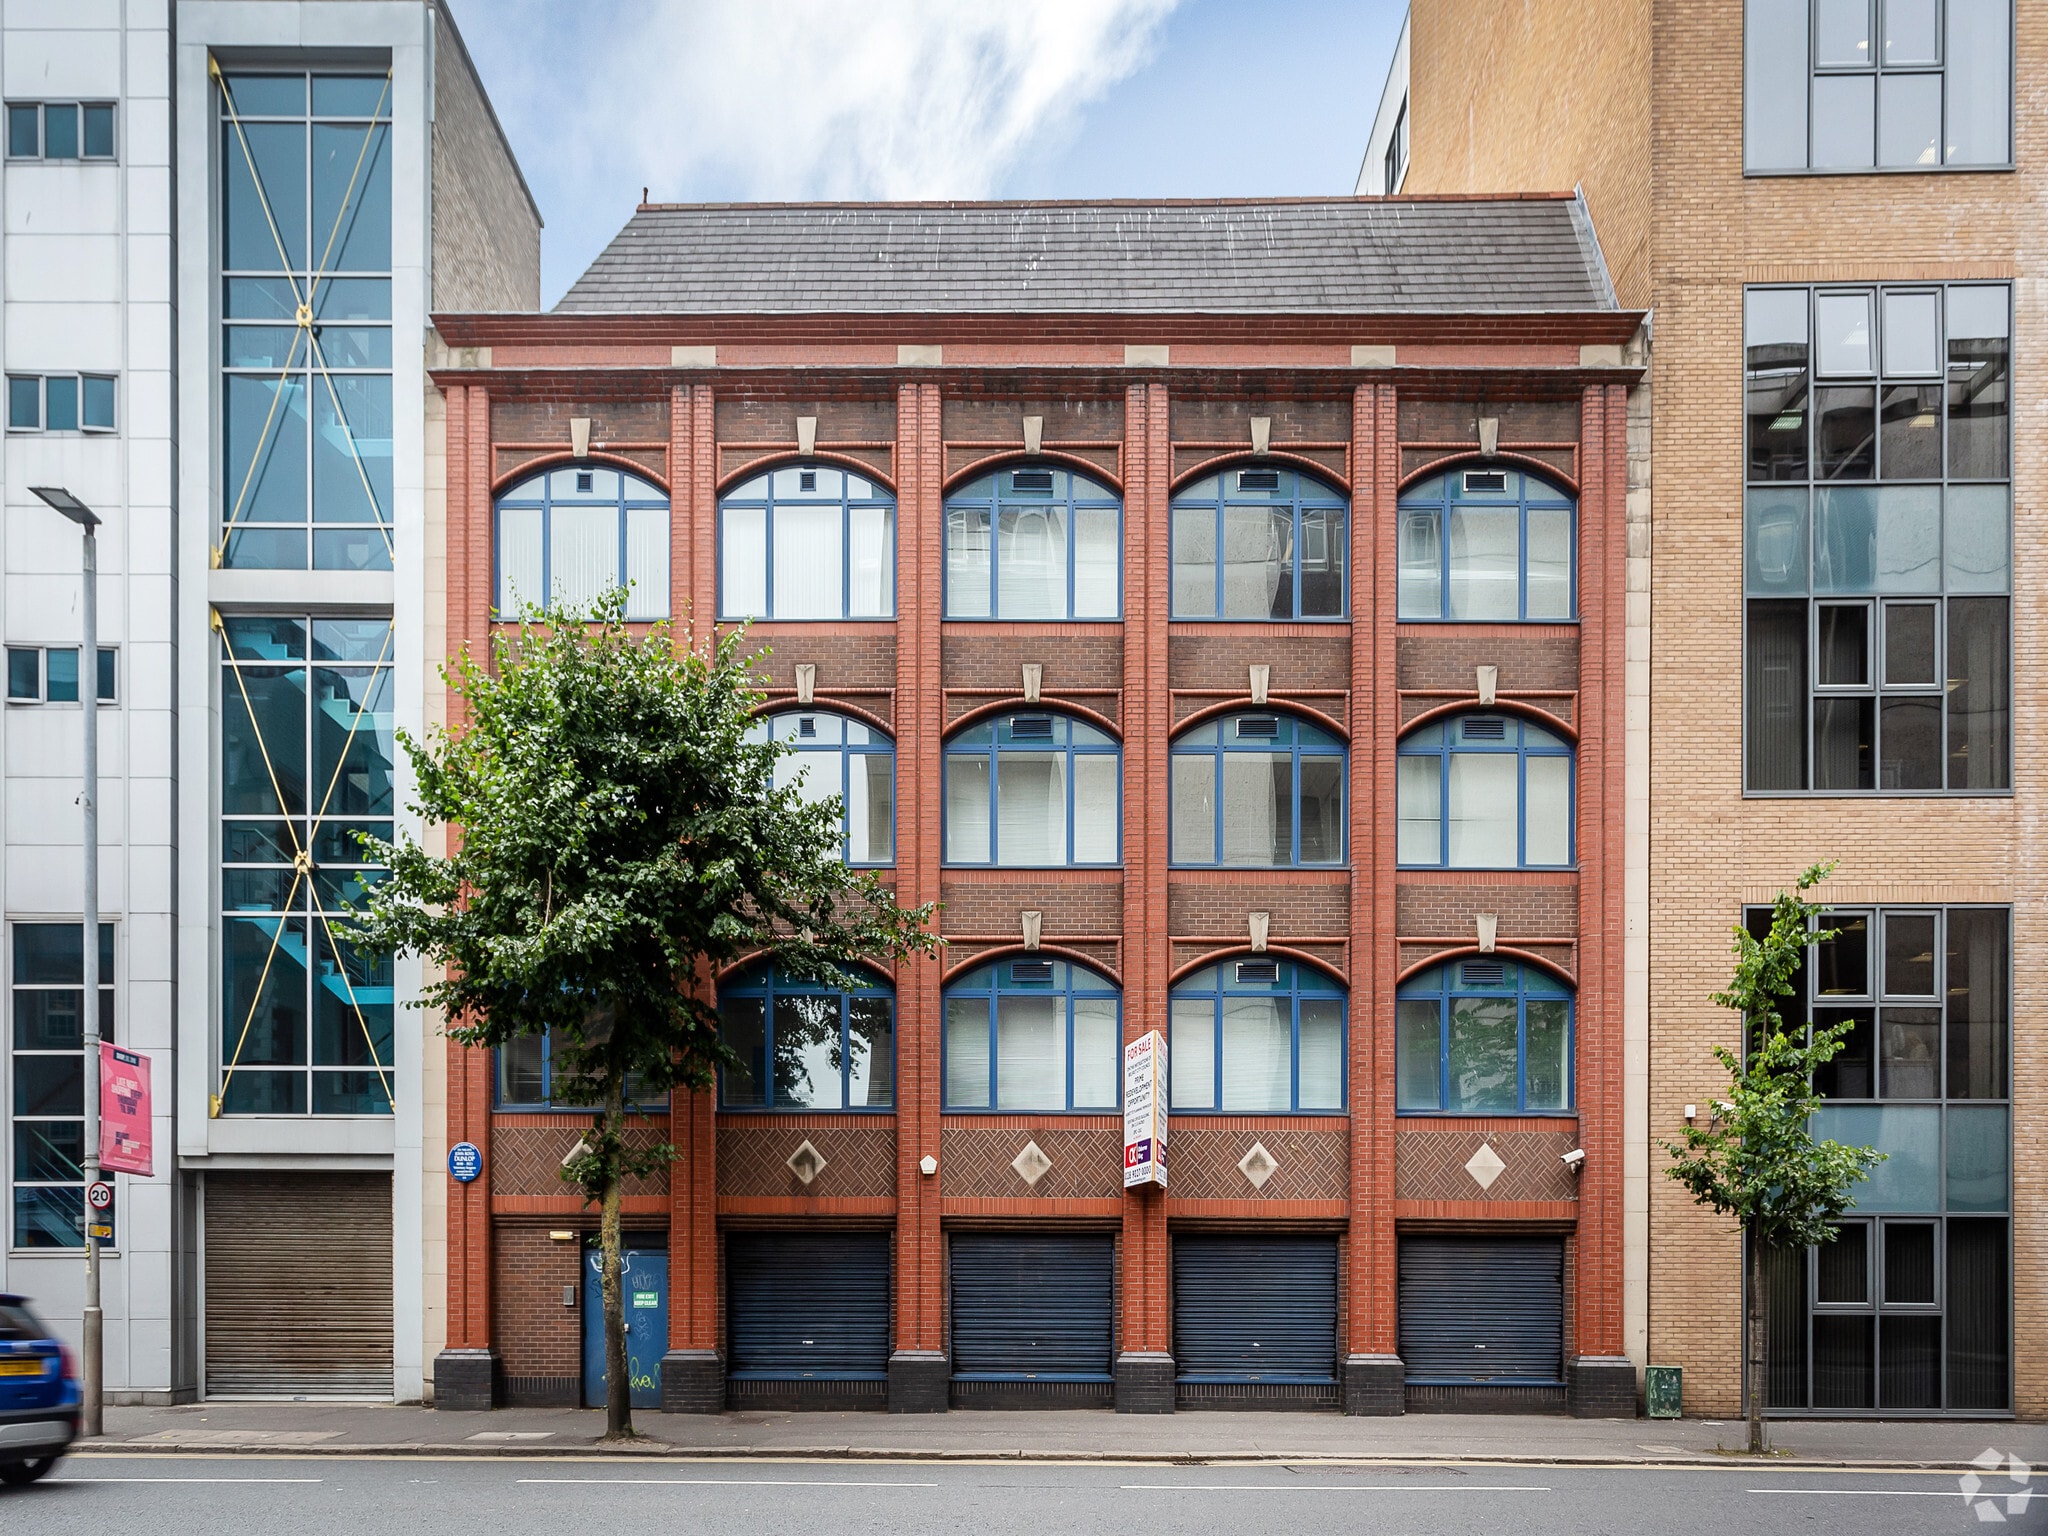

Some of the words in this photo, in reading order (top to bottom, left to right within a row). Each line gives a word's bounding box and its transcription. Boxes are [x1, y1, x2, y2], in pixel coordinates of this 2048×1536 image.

[1128, 1046, 1137, 1061] FOR
[1138, 1038, 1151, 1055] SALE
[92, 1190, 108, 1202] 20
